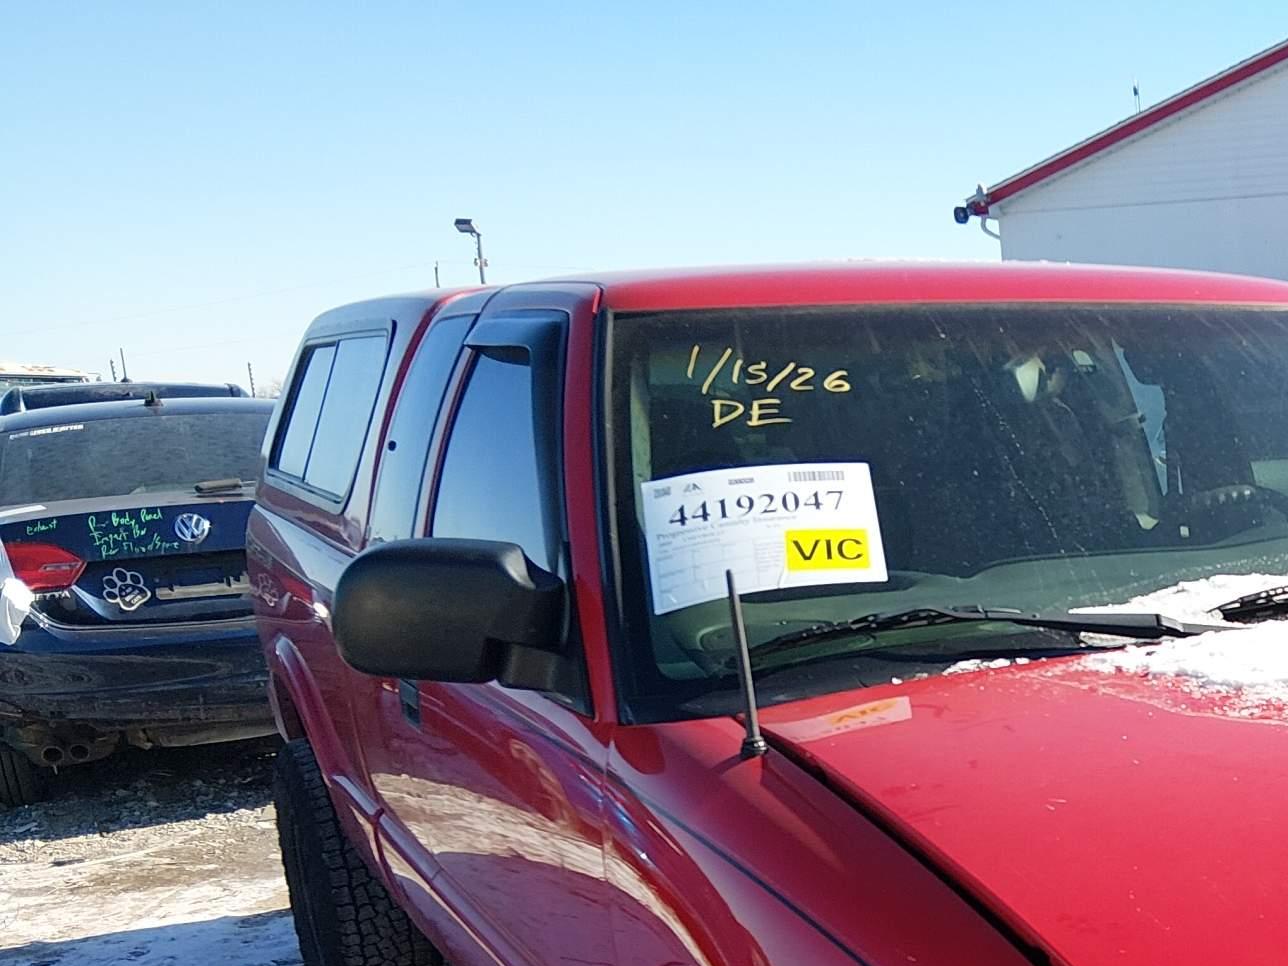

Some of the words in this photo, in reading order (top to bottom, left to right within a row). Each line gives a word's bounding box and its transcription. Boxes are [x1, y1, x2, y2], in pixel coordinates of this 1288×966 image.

[687, 345, 851, 395] 1/15/26
[711, 399, 793, 429] DE
[669, 489, 844, 527] 44192047
[792, 538, 864, 561] VIC
